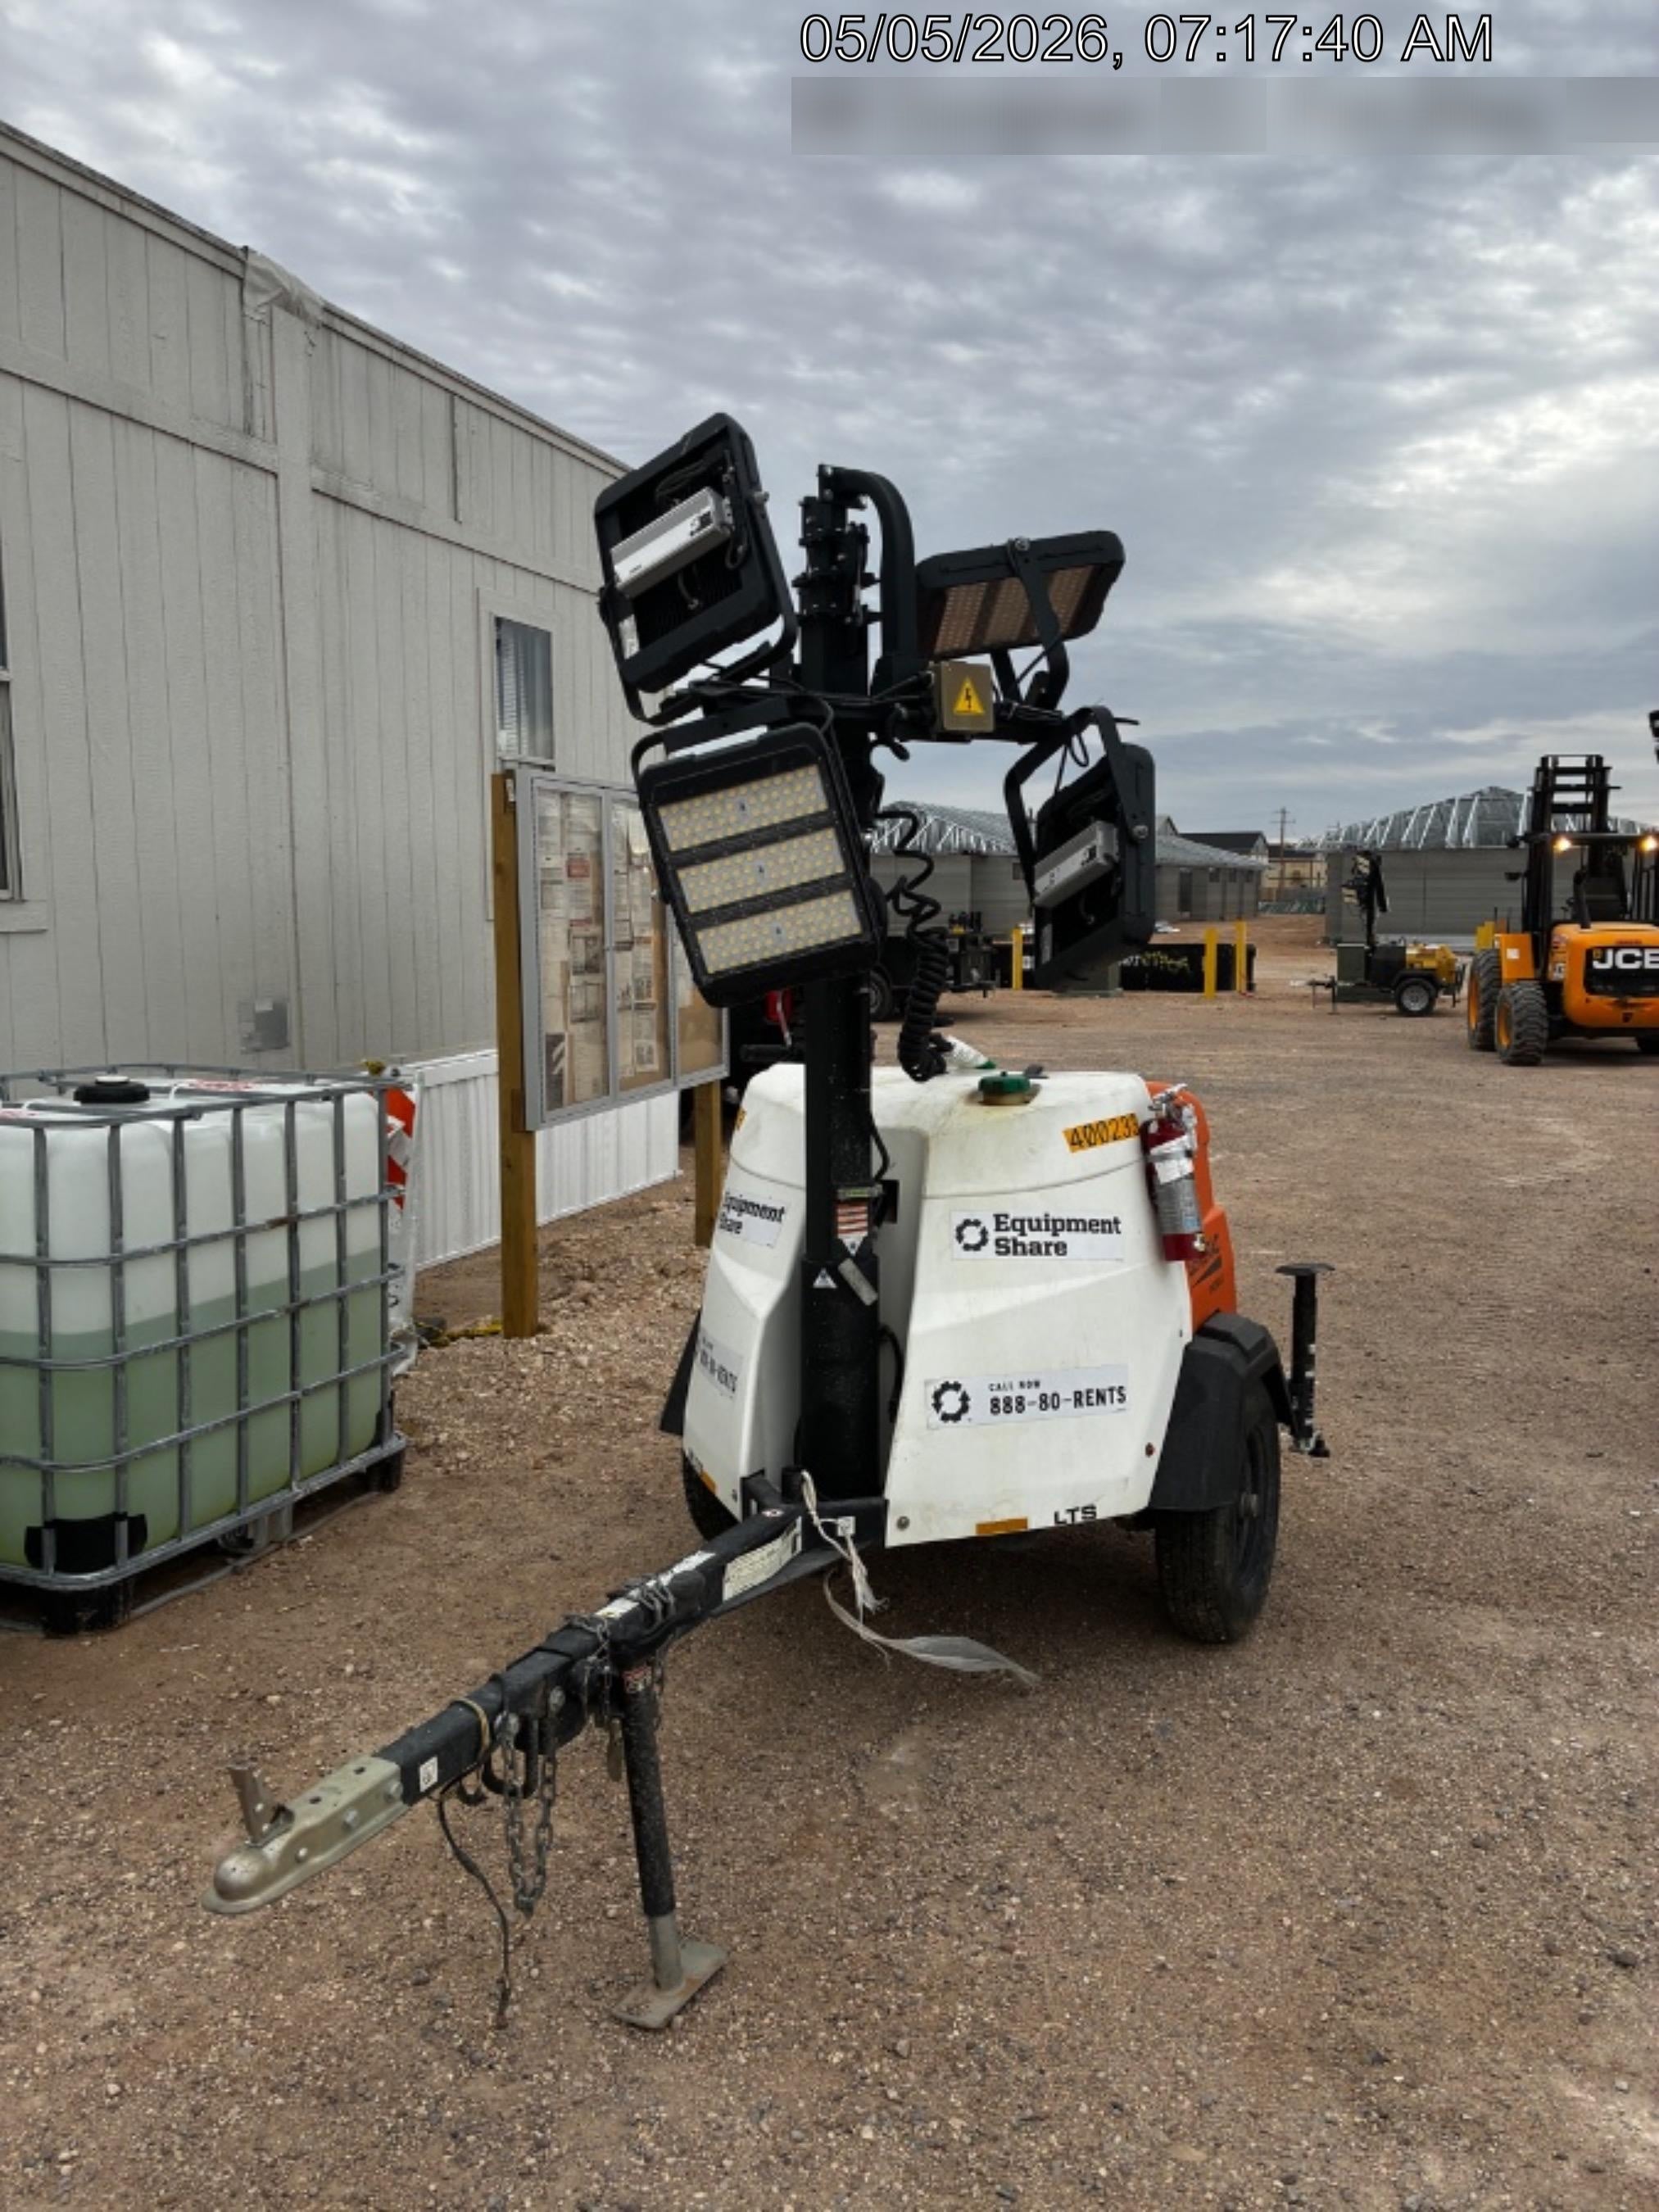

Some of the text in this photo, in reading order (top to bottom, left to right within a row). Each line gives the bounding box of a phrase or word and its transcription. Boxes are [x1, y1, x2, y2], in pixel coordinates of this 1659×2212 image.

[993, 1213, 1122, 1236] Equipment
[995, 1236, 1067, 1256] Share
[988, 1380, 1040, 1392] CALL NOW
[990, 1385, 1126, 1416] 888-80-RENTS
[1054, 1504, 1097, 1525] LTS
